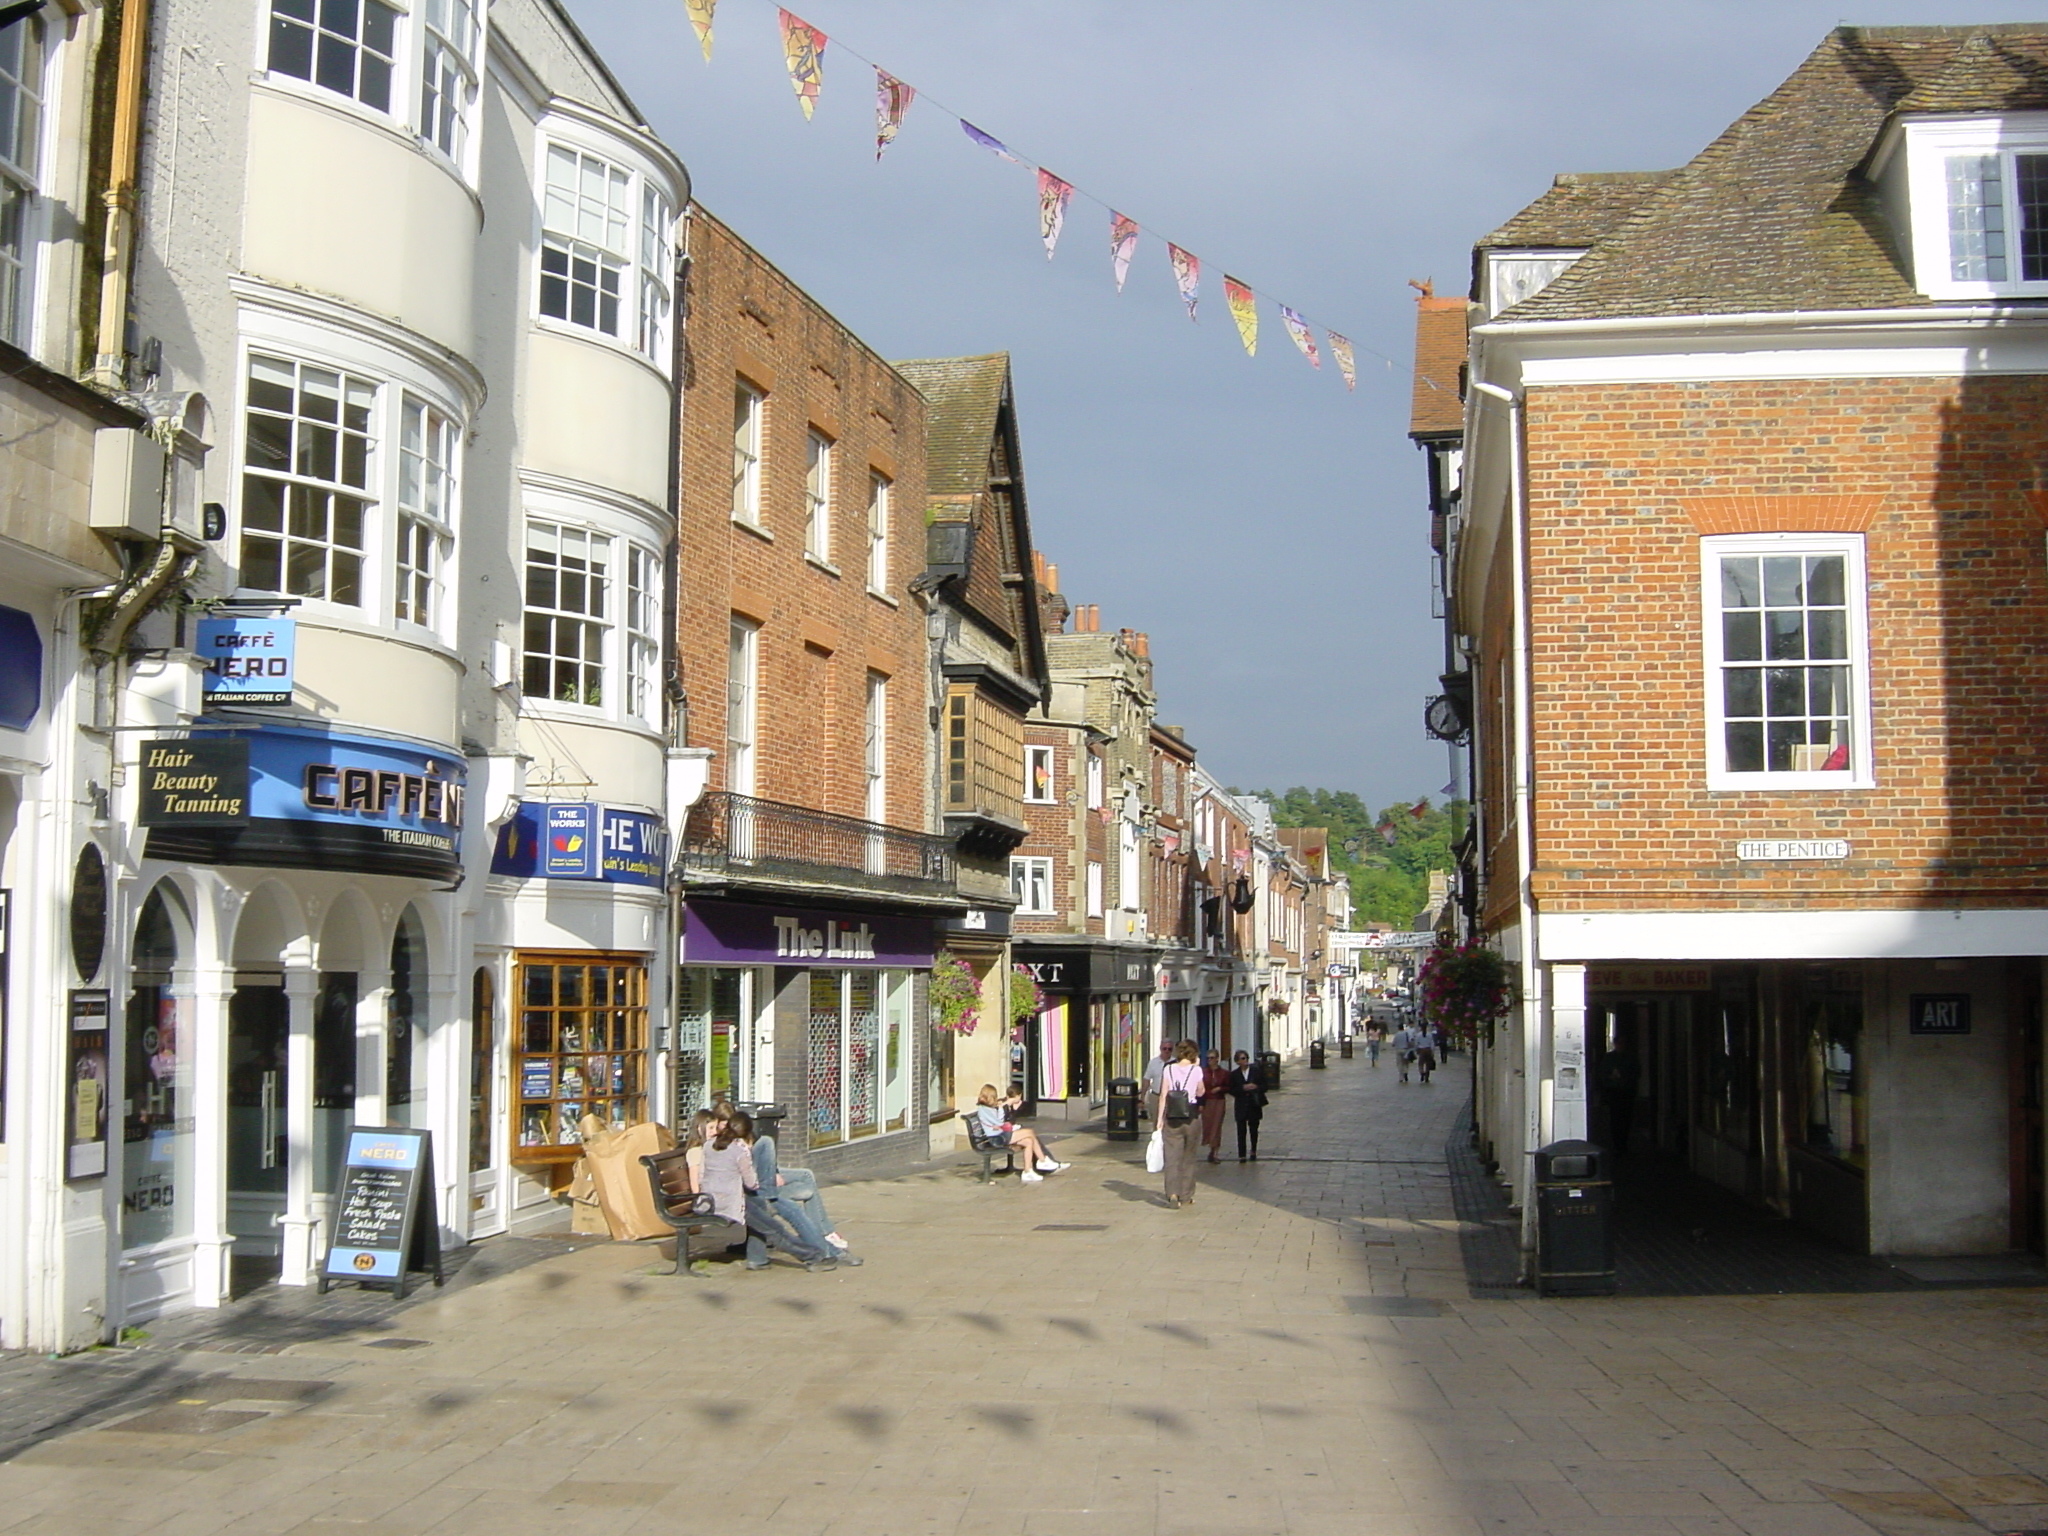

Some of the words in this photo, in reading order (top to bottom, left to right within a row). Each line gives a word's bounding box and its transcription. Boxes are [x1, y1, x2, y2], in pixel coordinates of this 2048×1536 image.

[214, 693, 245, 702] ITALIAN
[245, 693, 274, 702] COFFEE
[148, 748, 194, 768] Hair
[152, 771, 218, 793] Beauty
[164, 794, 242, 816] Tanning
[557, 810, 578, 819] THE
[550, 819, 586, 829] WORKS
[382, 828, 401, 844] THE
[401, 831, 432, 848] ITALIAN
[1741, 842, 1771, 858] THE
[1777, 842, 1845, 858] PENTICE
[773, 915, 824, 958] The
[826, 920, 876, 960] Link
[1653, 969, 1708, 985] BAKER
[1921, 1001, 1959, 1027] ART
[361, 1148, 407, 1161] NERO
[357, 1185, 390, 1198] Panini
[124, 1185, 174, 1214] NERO
[349, 1196, 366, 1207] Hot
[369, 1198, 393, 1209] Soup
[344, 1206, 372, 1218] Fresh
[374, 1208, 402, 1221] Pasta
[348, 1217, 387, 1231] Salads
[347, 1228, 379, 1241] Cakes
